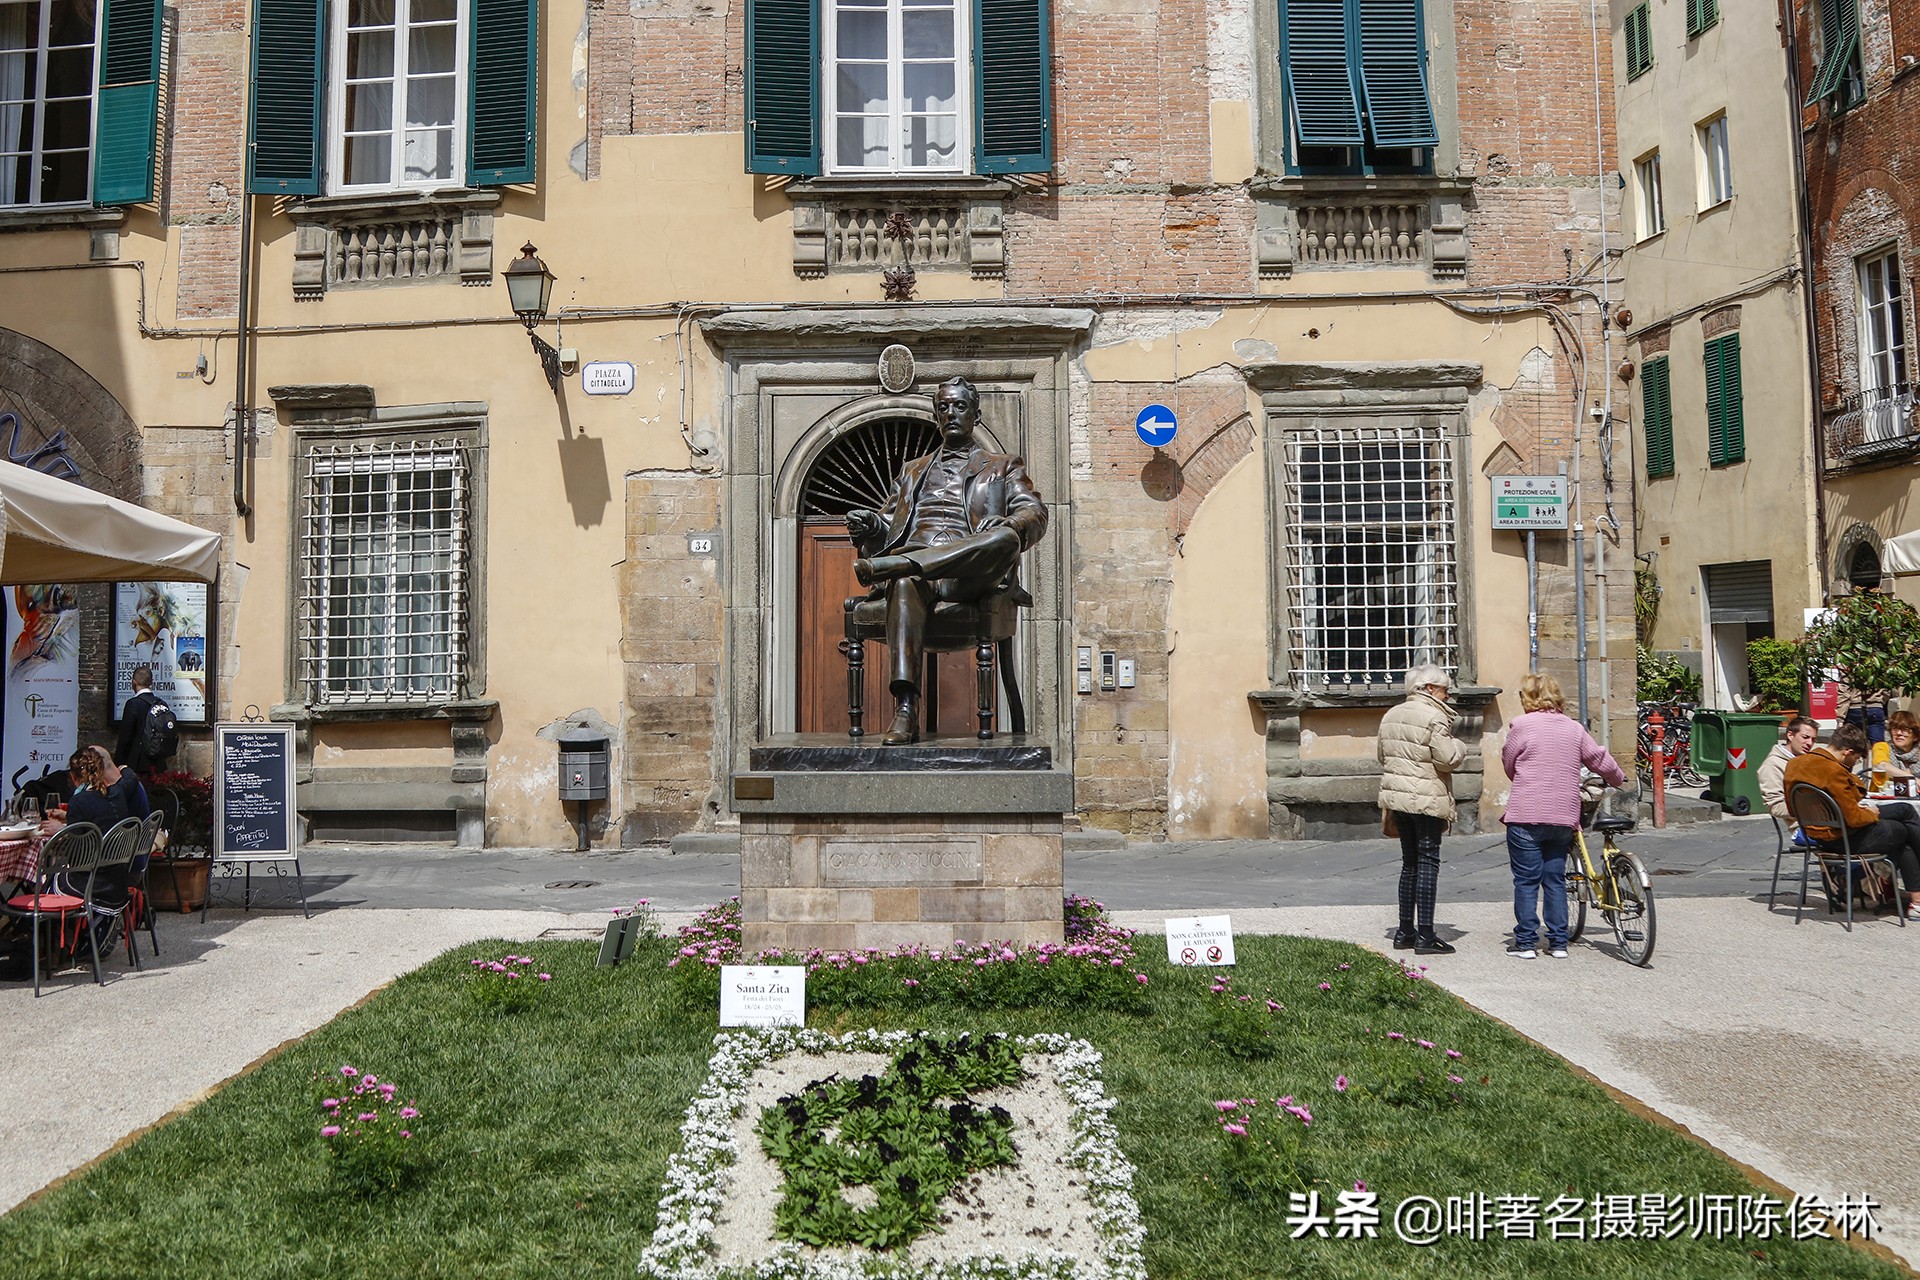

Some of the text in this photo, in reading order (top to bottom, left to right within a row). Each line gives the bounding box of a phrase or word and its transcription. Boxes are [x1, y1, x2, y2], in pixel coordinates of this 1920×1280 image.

[595, 369, 622, 378] PIAZZA
[590, 380, 627, 388] CITTADELLA
[1509, 507, 1517, 516] A
[695, 541, 708, 551] 34
[40, 753, 65, 762] PICTET
[830, 852, 973, 869] GIACOMO PUCCINI
[1188, 930, 1228, 939] CALPESTARE
[736, 983, 790, 994] Santa Zita
